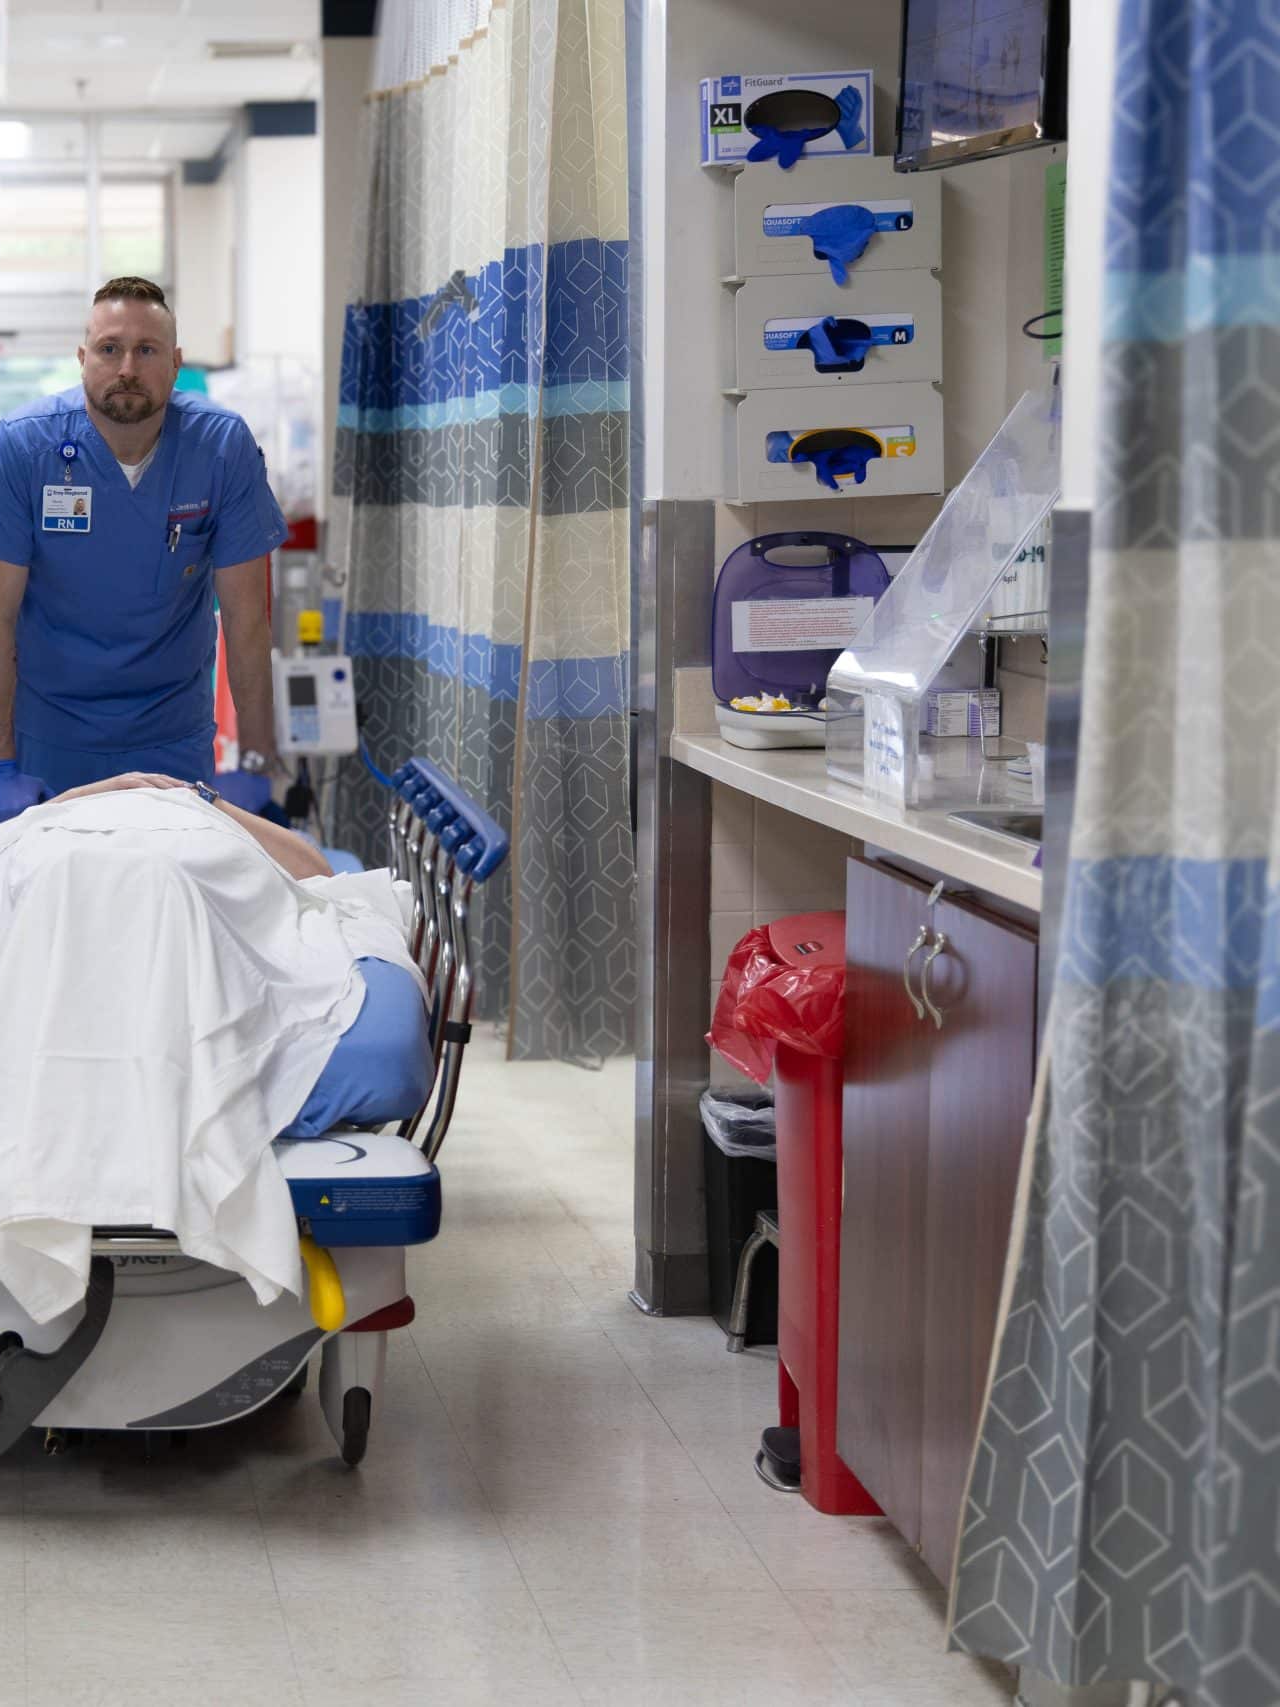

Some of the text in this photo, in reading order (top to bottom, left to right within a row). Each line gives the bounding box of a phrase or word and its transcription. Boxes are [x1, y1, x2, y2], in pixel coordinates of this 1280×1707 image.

[745, 78, 783, 88] FitGuard
[713, 107, 739, 125] XL
[764, 218, 801, 226] QUASOFT
[900, 218, 907, 229] L
[894, 331, 906, 343] M
[57, 518, 75, 529] RN
